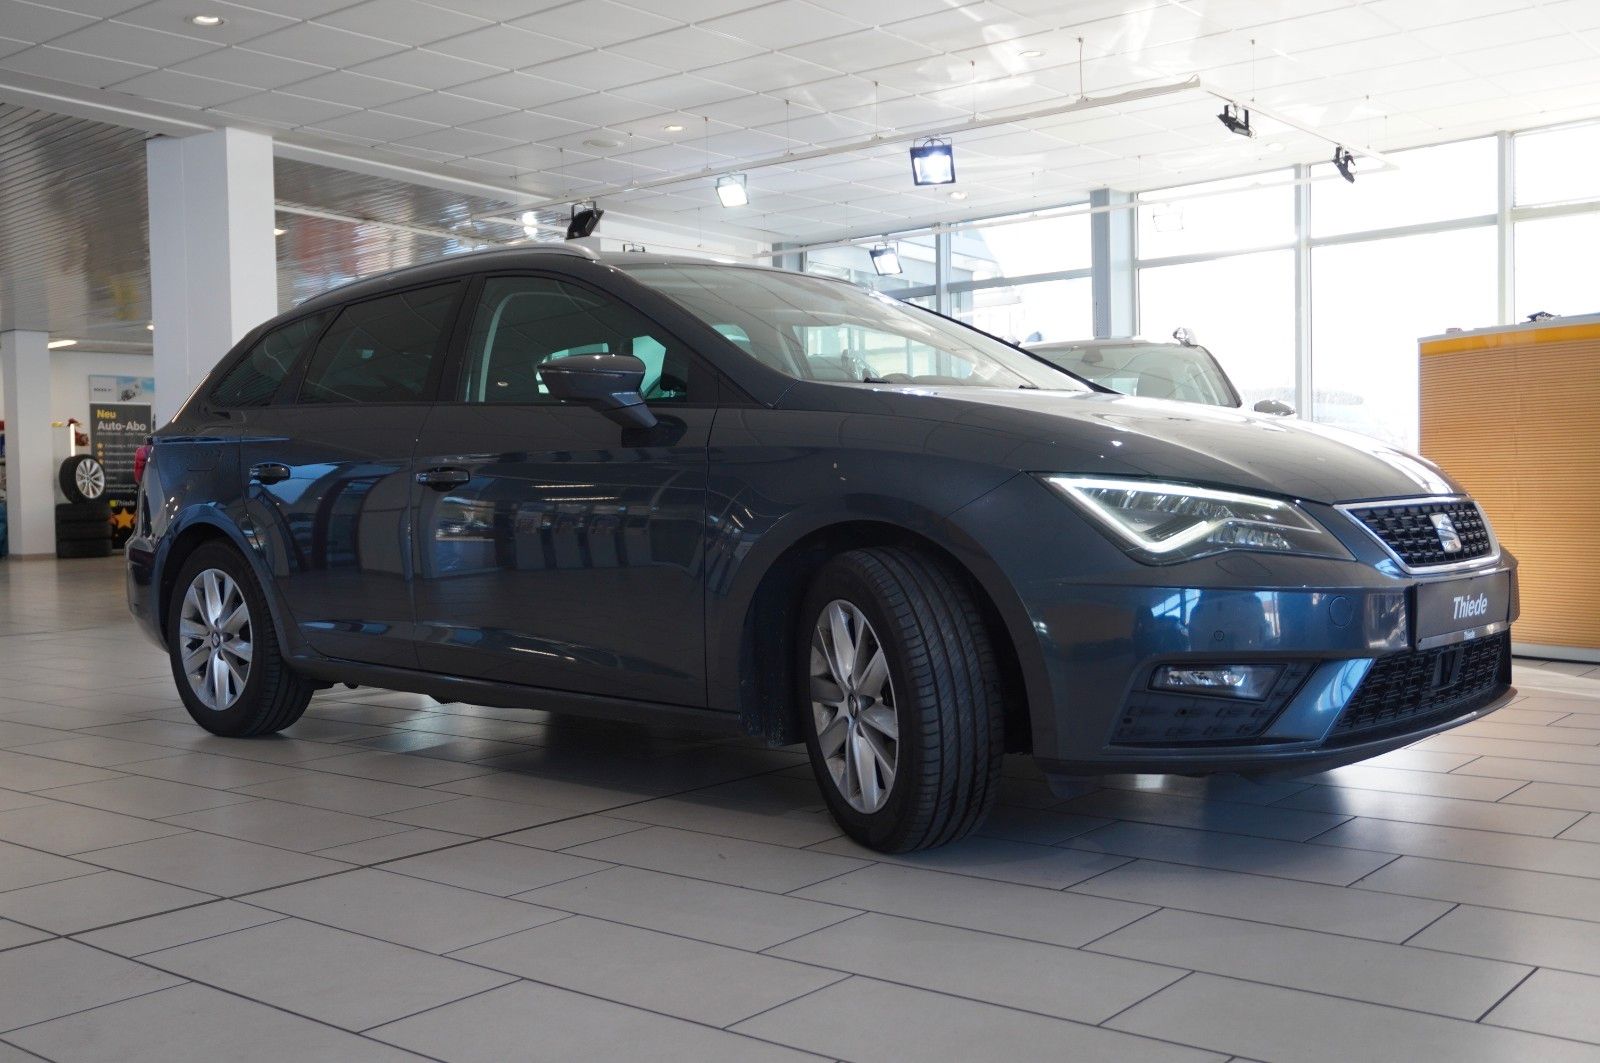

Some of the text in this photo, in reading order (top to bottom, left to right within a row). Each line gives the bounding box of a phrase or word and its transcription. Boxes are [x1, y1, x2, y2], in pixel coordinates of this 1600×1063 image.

[96, 410, 116, 418] Neu
[97, 421, 146, 431] Auto-Abo
[1453, 593, 1488, 619] Thiede
